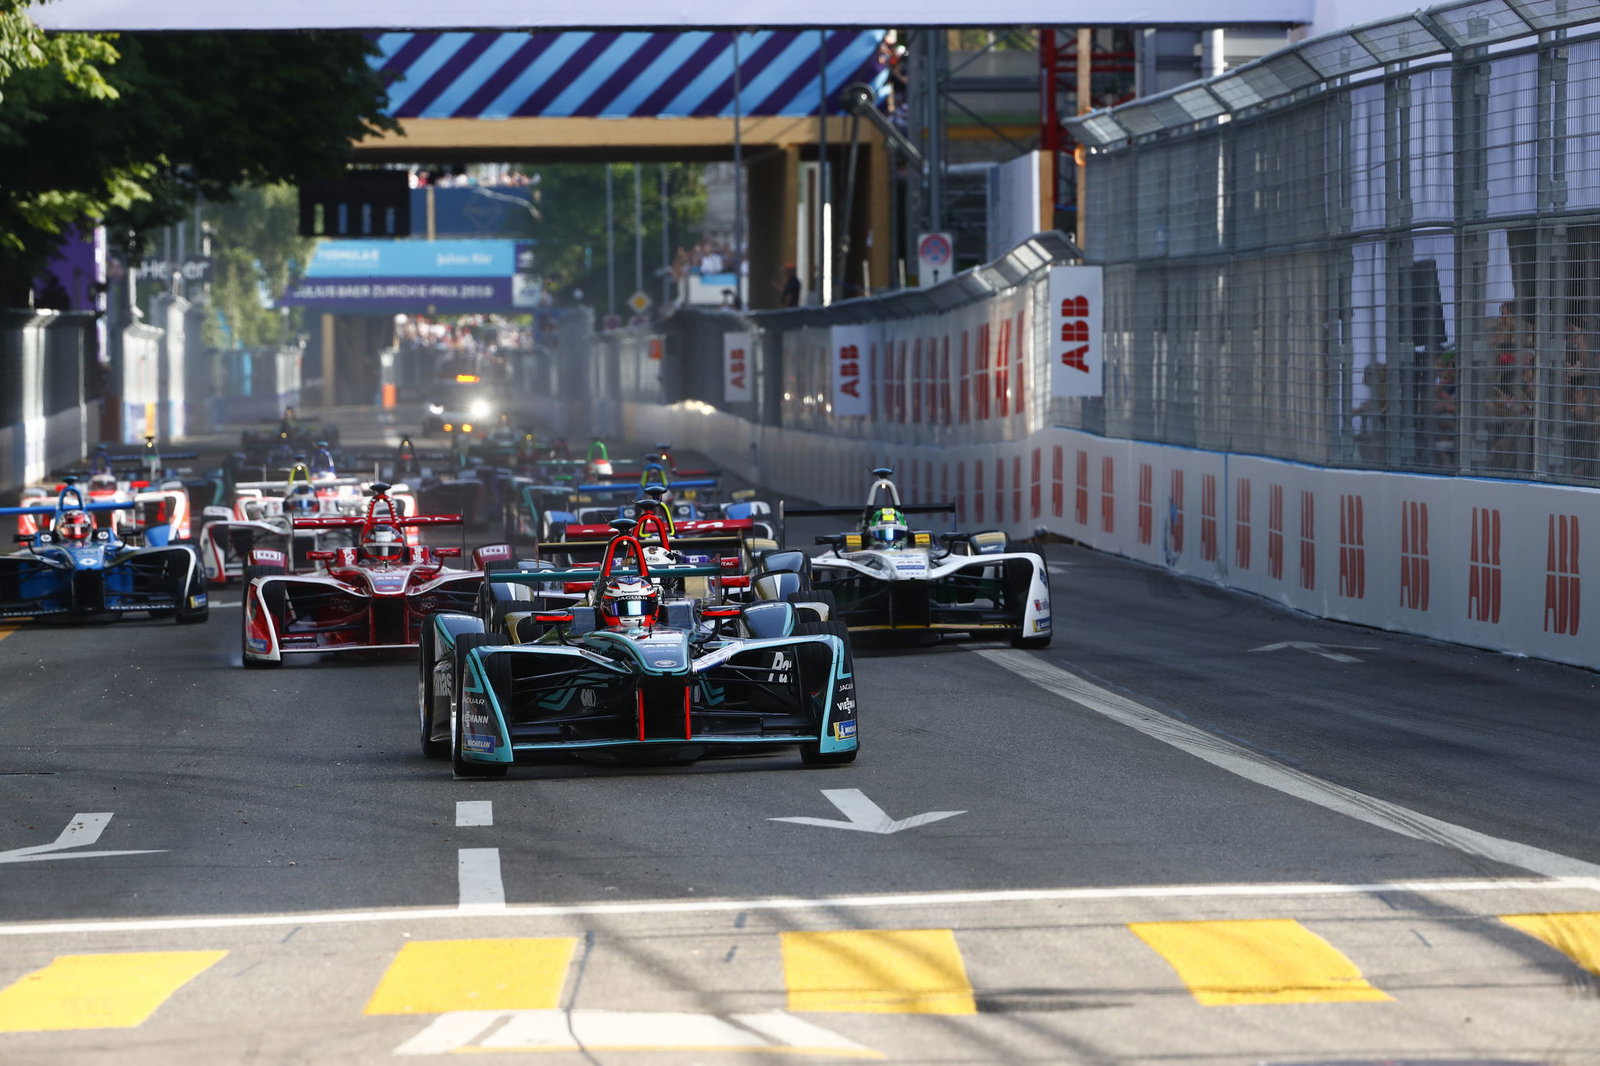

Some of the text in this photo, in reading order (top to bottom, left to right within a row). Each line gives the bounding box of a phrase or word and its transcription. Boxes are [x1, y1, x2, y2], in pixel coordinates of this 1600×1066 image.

[730, 348, 746, 390] ABB
[840, 344, 860, 399] ABB
[1061, 296, 1089, 374] ABB
[1339, 494, 1365, 599] ABB
[1400, 500, 1430, 612] ABB
[1467, 506, 1502, 625] ABB
[1544, 513, 1581, 637] ABB
